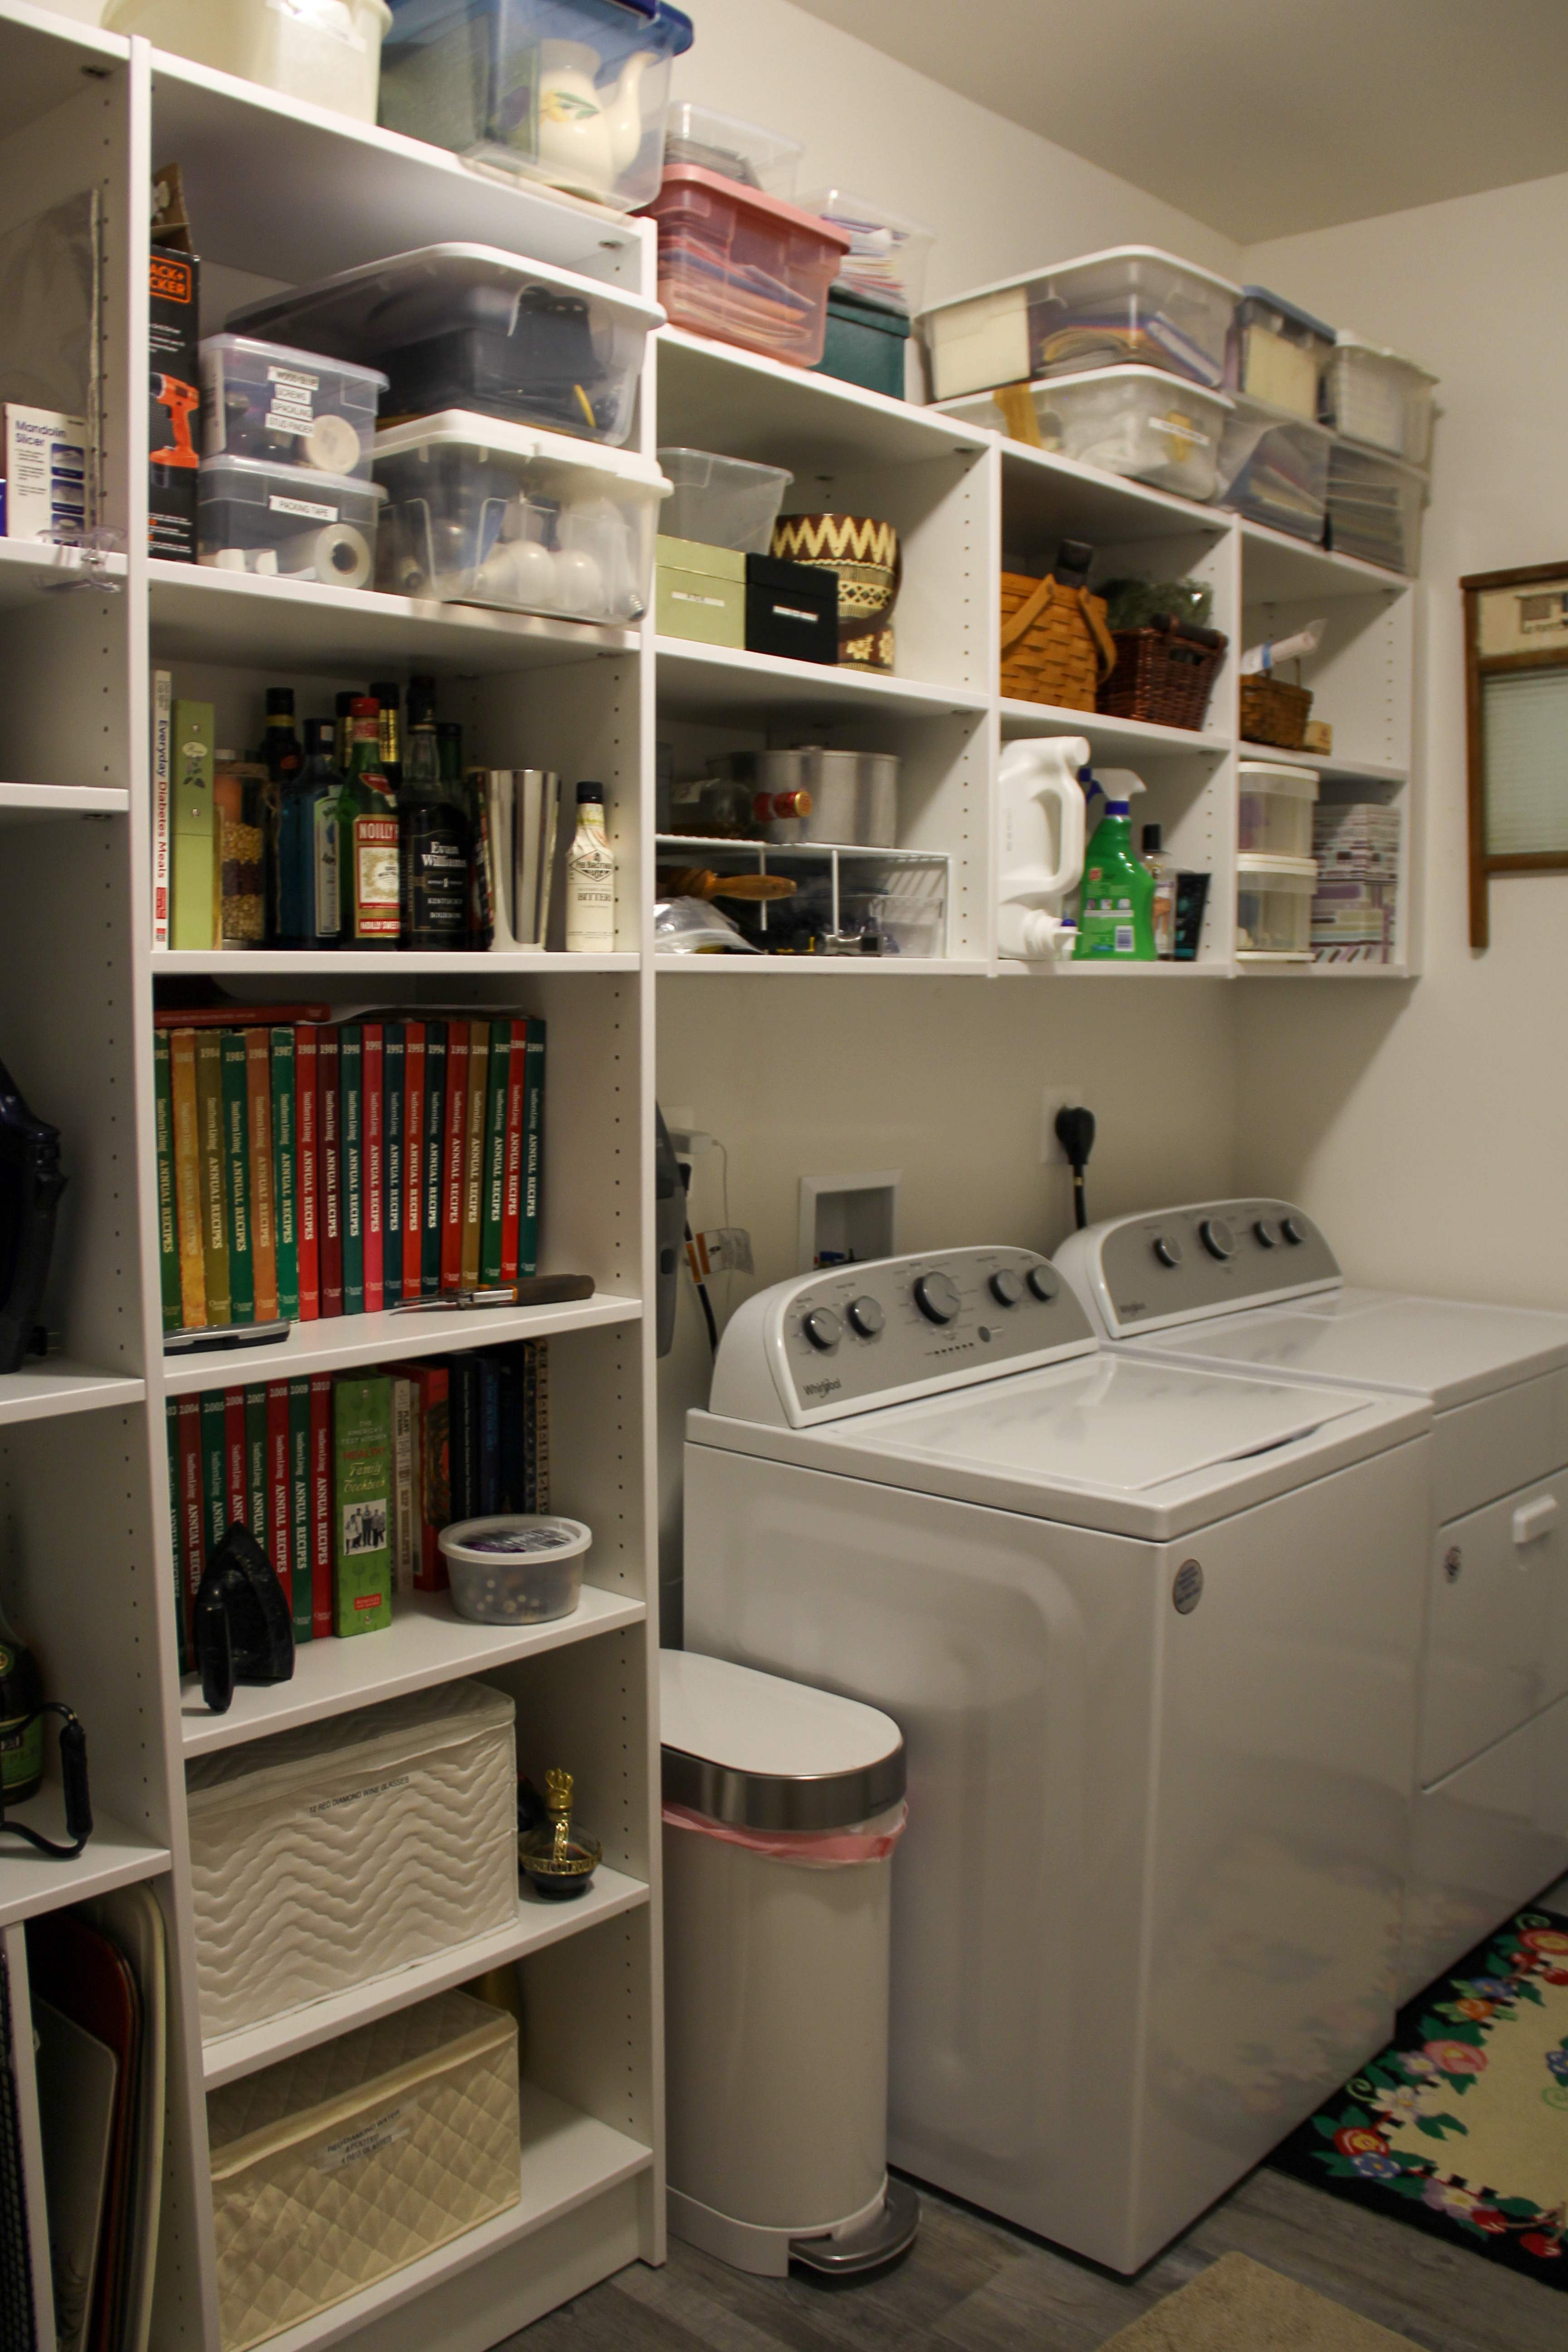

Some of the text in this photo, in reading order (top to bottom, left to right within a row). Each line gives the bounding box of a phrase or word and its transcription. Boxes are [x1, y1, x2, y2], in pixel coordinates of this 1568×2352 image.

[149, 276, 185, 295] CKER
[150, 264, 184, 280] ACK+
[15, 420, 66, 438] Mandolin
[15, 432, 45, 446] Slicer
[156, 719, 168, 777] Everyday
[158, 781, 168, 838] Diabetes
[157, 841, 167, 878] Meals
[209, 1157, 220, 1201] ANNUAL
[281, 1153, 291, 1197] ANNUAL
[304, 1150, 314, 1194] ANNUAL
[326, 1148, 337, 1192] ANNUAL
[348, 1148, 359, 1191] ANNUAL
[370, 1144, 379, 1187] ANNUAL
[410, 1142, 419, 1185] ANNUAL
[451, 1138, 461, 1180] ANNUAL
[470, 1138, 481, 1179] ANNUAL
[491, 1136, 504, 1221] ANNUAL RECIPES
[508, 1132, 520, 1215] ANNUAL RECIPES
[527, 1134, 538, 1217] ANNUAL RECIPES
[159, 1159, 171, 1205] ANNUAL
[233, 1160, 244, 1205] ANNUAL
[257, 1156, 270, 1247] ANNUAL RECIPES
[389, 1144, 399, 1232] ANNUAL RECIPES
[428, 1142, 439, 1229] ANNUAL RECIPES
[449, 1182, 459, 1224] RECIPES
[468, 1181, 479, 1223] RECIPES
[162, 1207, 174, 1253] RECIPES
[210, 1204, 223, 1249] RECIPES
[235, 1206, 247, 1252] RECIPES
[282, 1199, 293, 1244] RECIPES
[304, 1196, 314, 1240] RECIPES
[327, 1194, 338, 1238] RECIPES
[349, 1193, 360, 1237] RECIPES
[370, 1190, 380, 1232] RECIPES
[409, 1188, 418, 1231] RECIPES
[802, 1377, 842, 1398] Whirlpool
[349, 1461, 382, 1476] Family
[253, 1491, 264, 1534] ANNUAL
[275, 1484, 287, 1528] ANNUAL
[295, 1481, 306, 1524] ANNUAL
[317, 1477, 328, 1520] ANNUAL
[188, 1503, 199, 1548] ANNUAL
[296, 1526, 308, 1569] RECIPES
[318, 1522, 328, 1565] RECIPES
[276, 1529, 288, 1573] RECIPES
[309, 1775, 410, 1813] 12 RED DIAMOND WINE GLASSES
